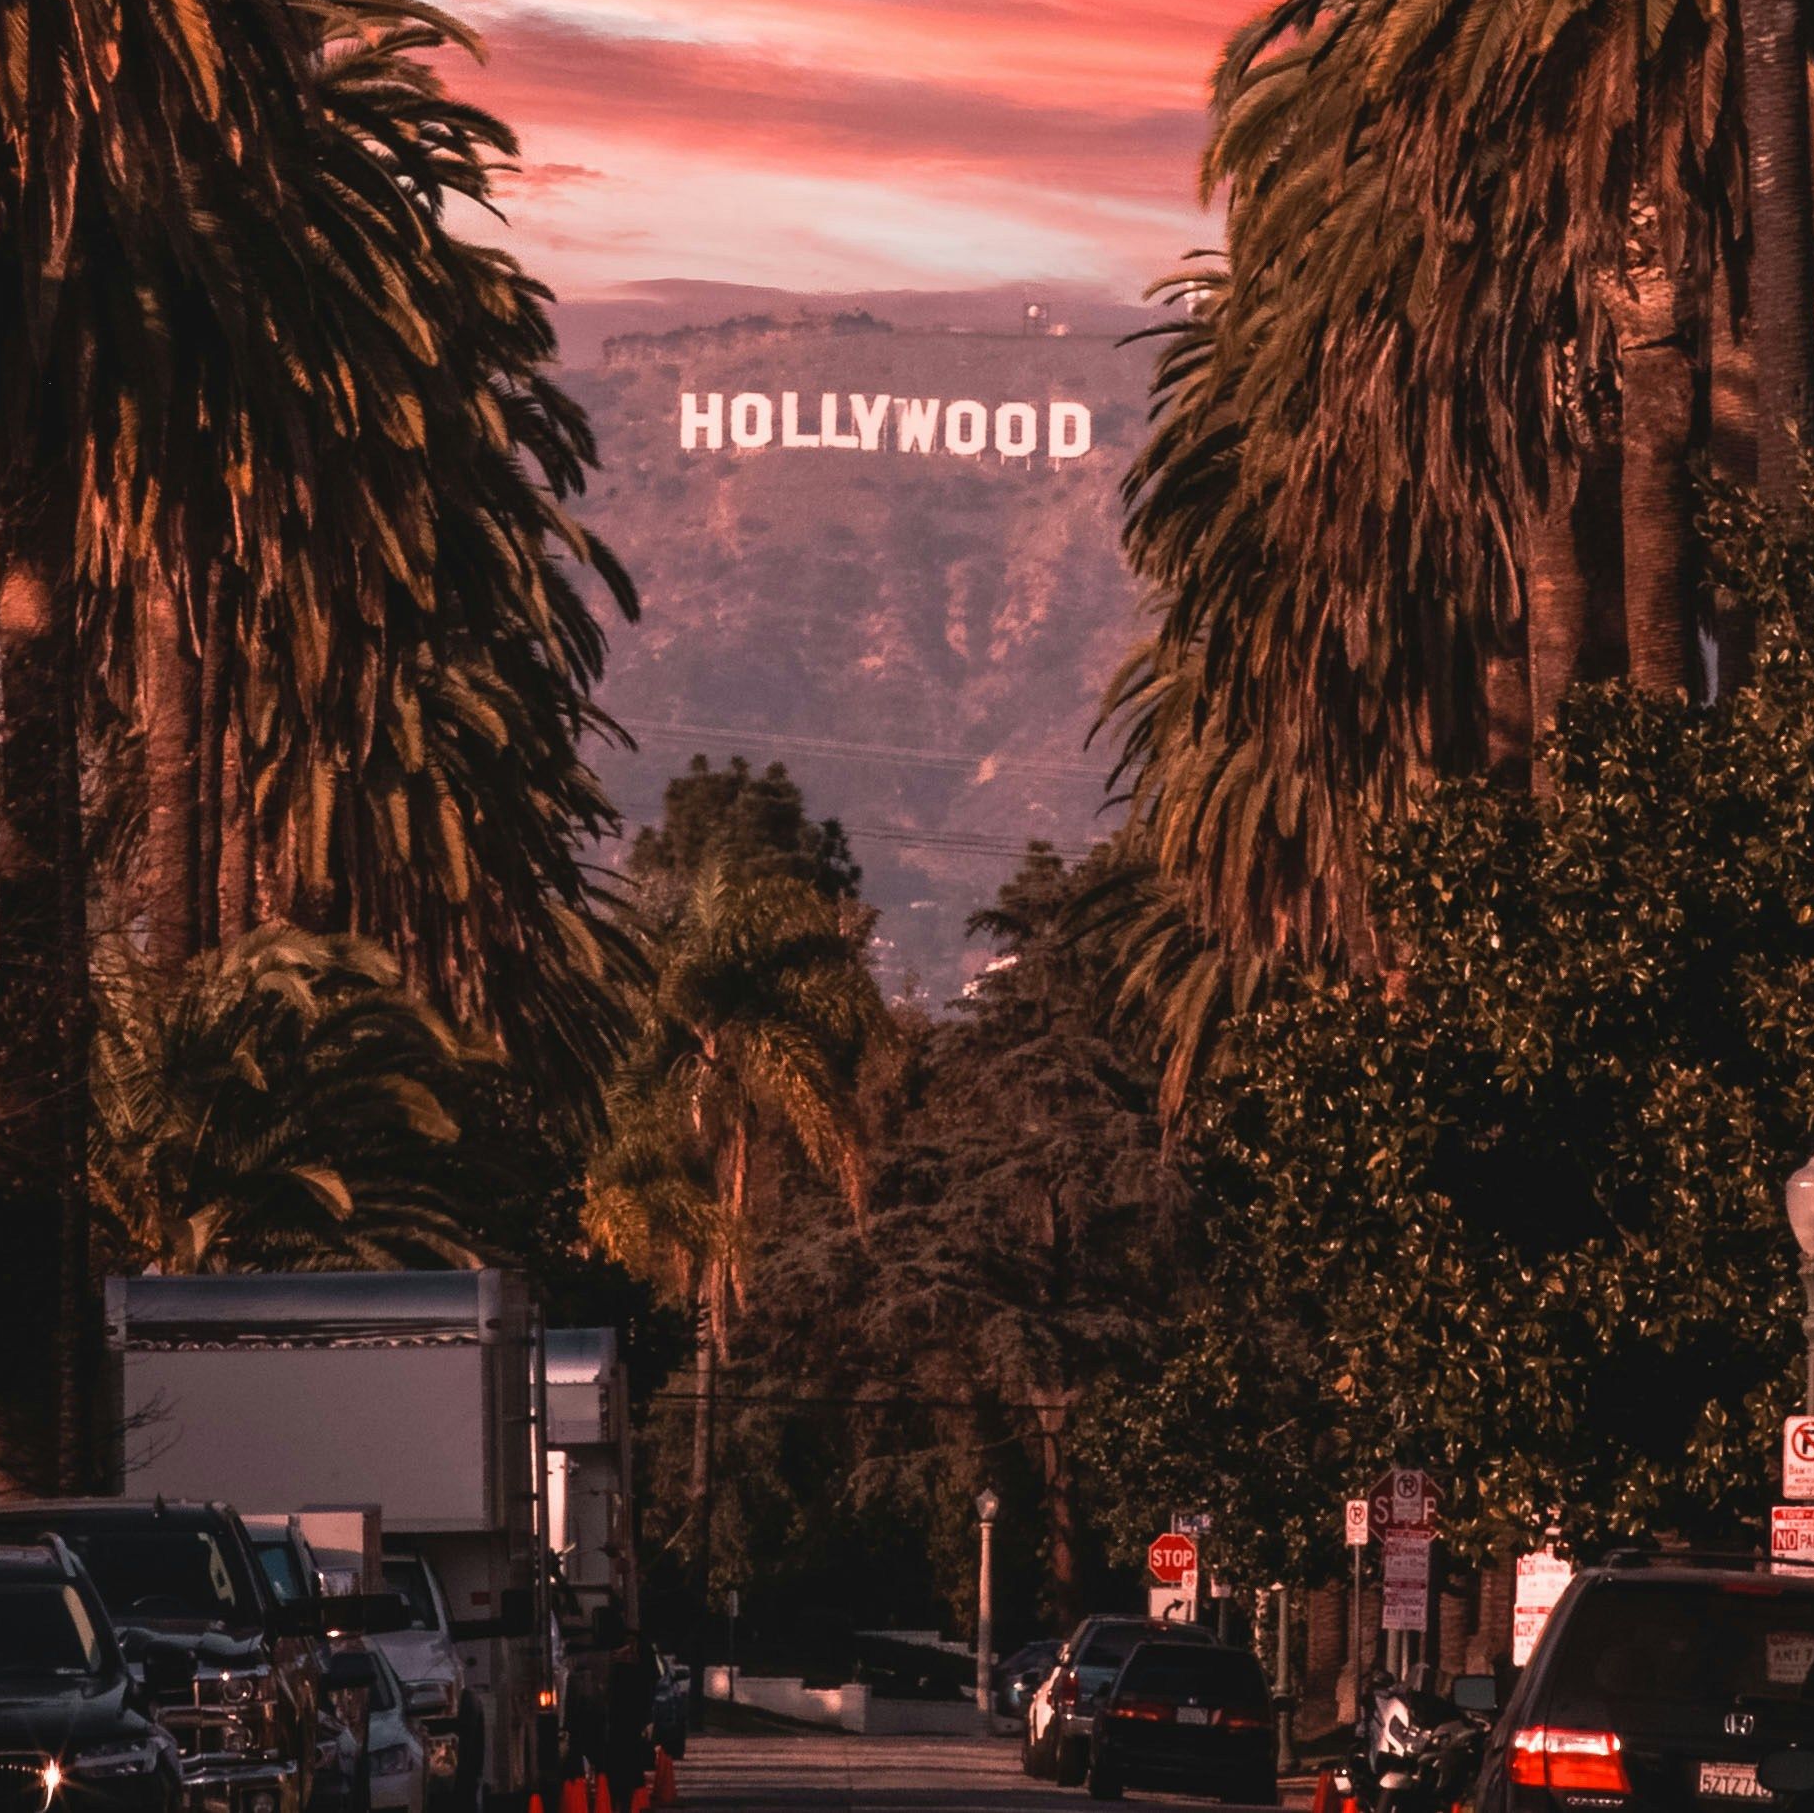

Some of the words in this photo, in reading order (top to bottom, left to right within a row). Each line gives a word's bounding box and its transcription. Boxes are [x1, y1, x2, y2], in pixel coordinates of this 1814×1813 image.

[680, 391, 1091, 459] HOLLYWOOD
[1374, 1495, 1437, 1525] SP
[1776, 1530, 1797, 1550] NO
[1152, 1548, 1193, 1568] STOP
